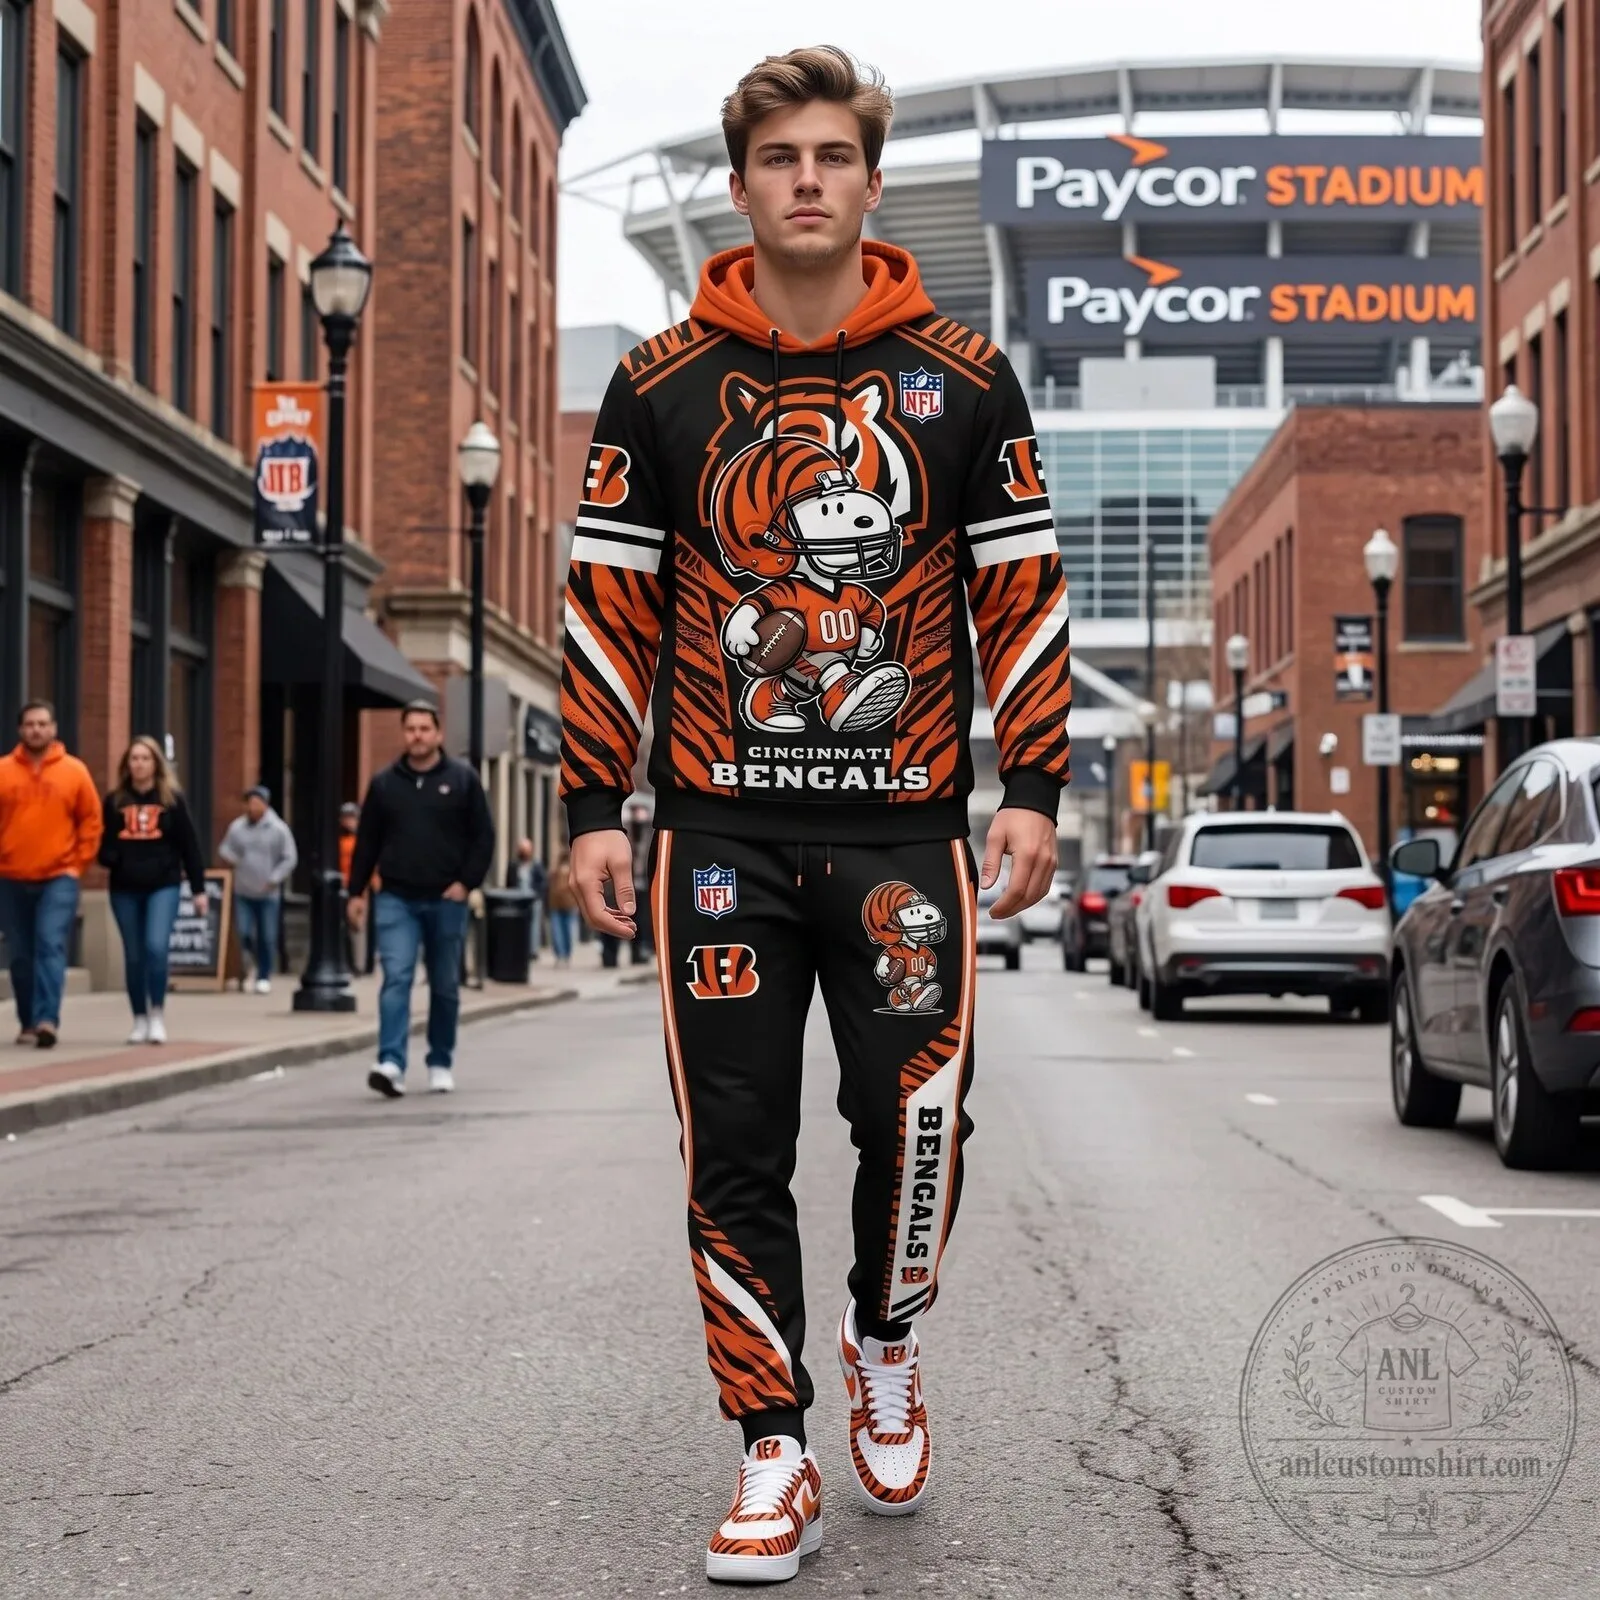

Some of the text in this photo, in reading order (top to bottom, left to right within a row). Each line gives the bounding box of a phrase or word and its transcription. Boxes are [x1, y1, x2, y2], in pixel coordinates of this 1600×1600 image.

[1016, 156, 1484, 221] Paycor STADIUM
[1047, 276, 1475, 335] Paycor STADIUM
[904, 390, 940, 416] NFL
[818, 607, 857, 644] 00
[747, 746, 893, 760] CINCINNATI
[709, 762, 931, 791] BENGALS
[698, 887, 733, 911] NFL
[910, 956, 926, 973] 00
[905, 1105, 943, 1260] BENGALS
